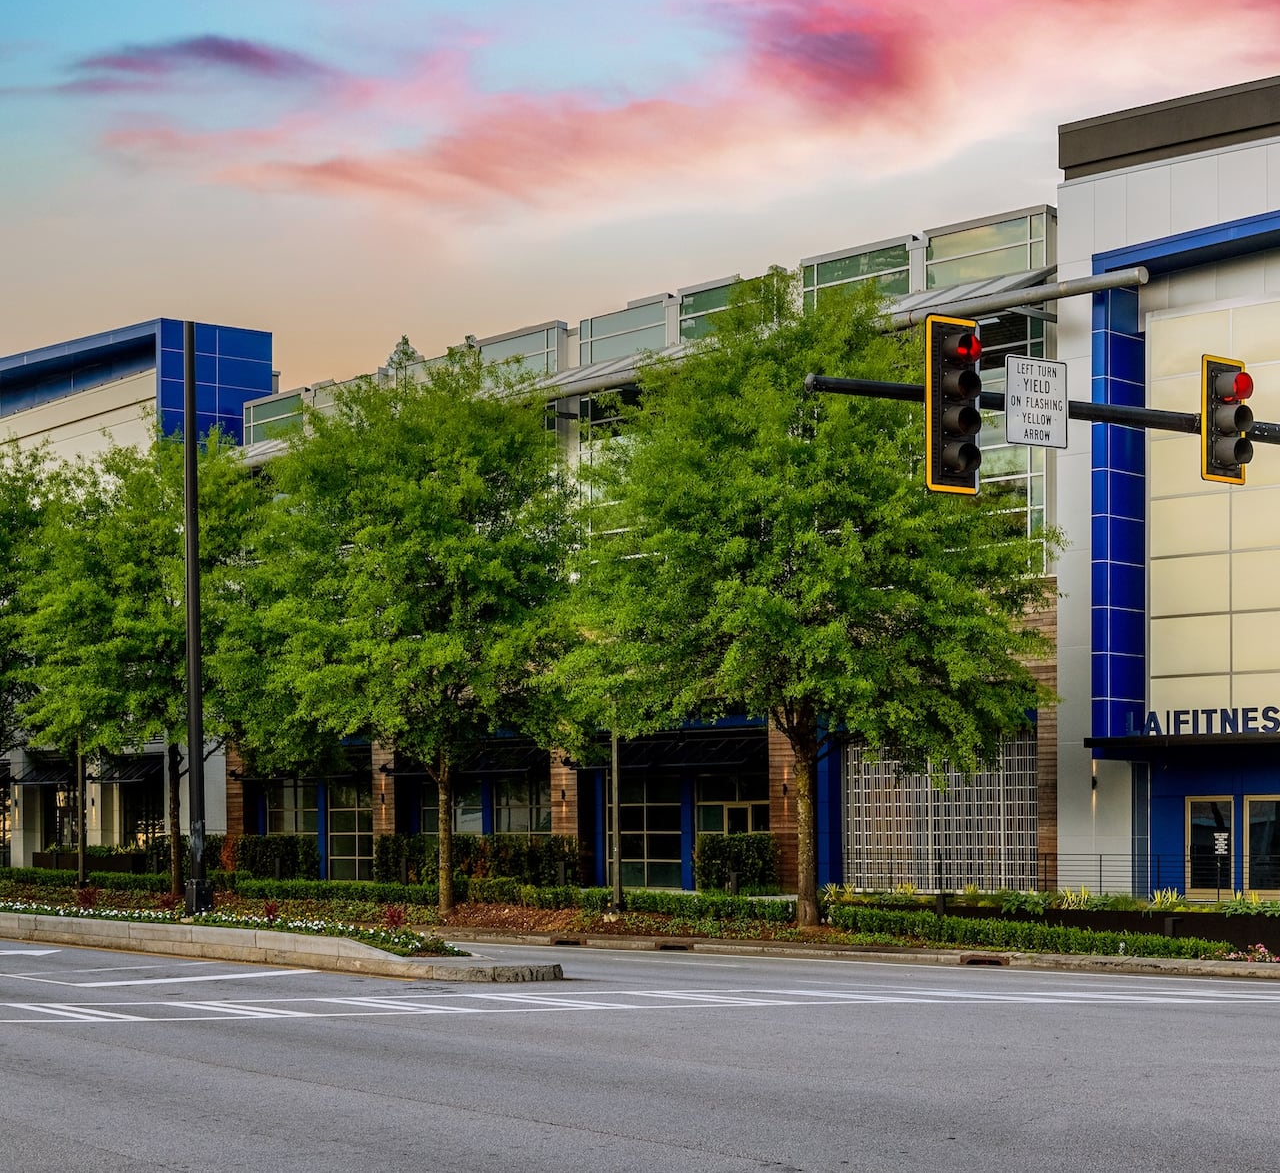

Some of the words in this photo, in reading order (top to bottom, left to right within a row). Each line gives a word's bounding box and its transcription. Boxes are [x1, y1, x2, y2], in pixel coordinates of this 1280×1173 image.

[1017, 362, 1034, 376] LEFT
[1038, 365, 1057, 378] TURN
[1023, 378, 1051, 394] YIELD
[1010, 395, 1021, 407] ON
[1026, 396, 1063, 412] FLASHING
[1022, 412, 1052, 426] YELLOW
[1023, 428, 1051, 442] ARROW
